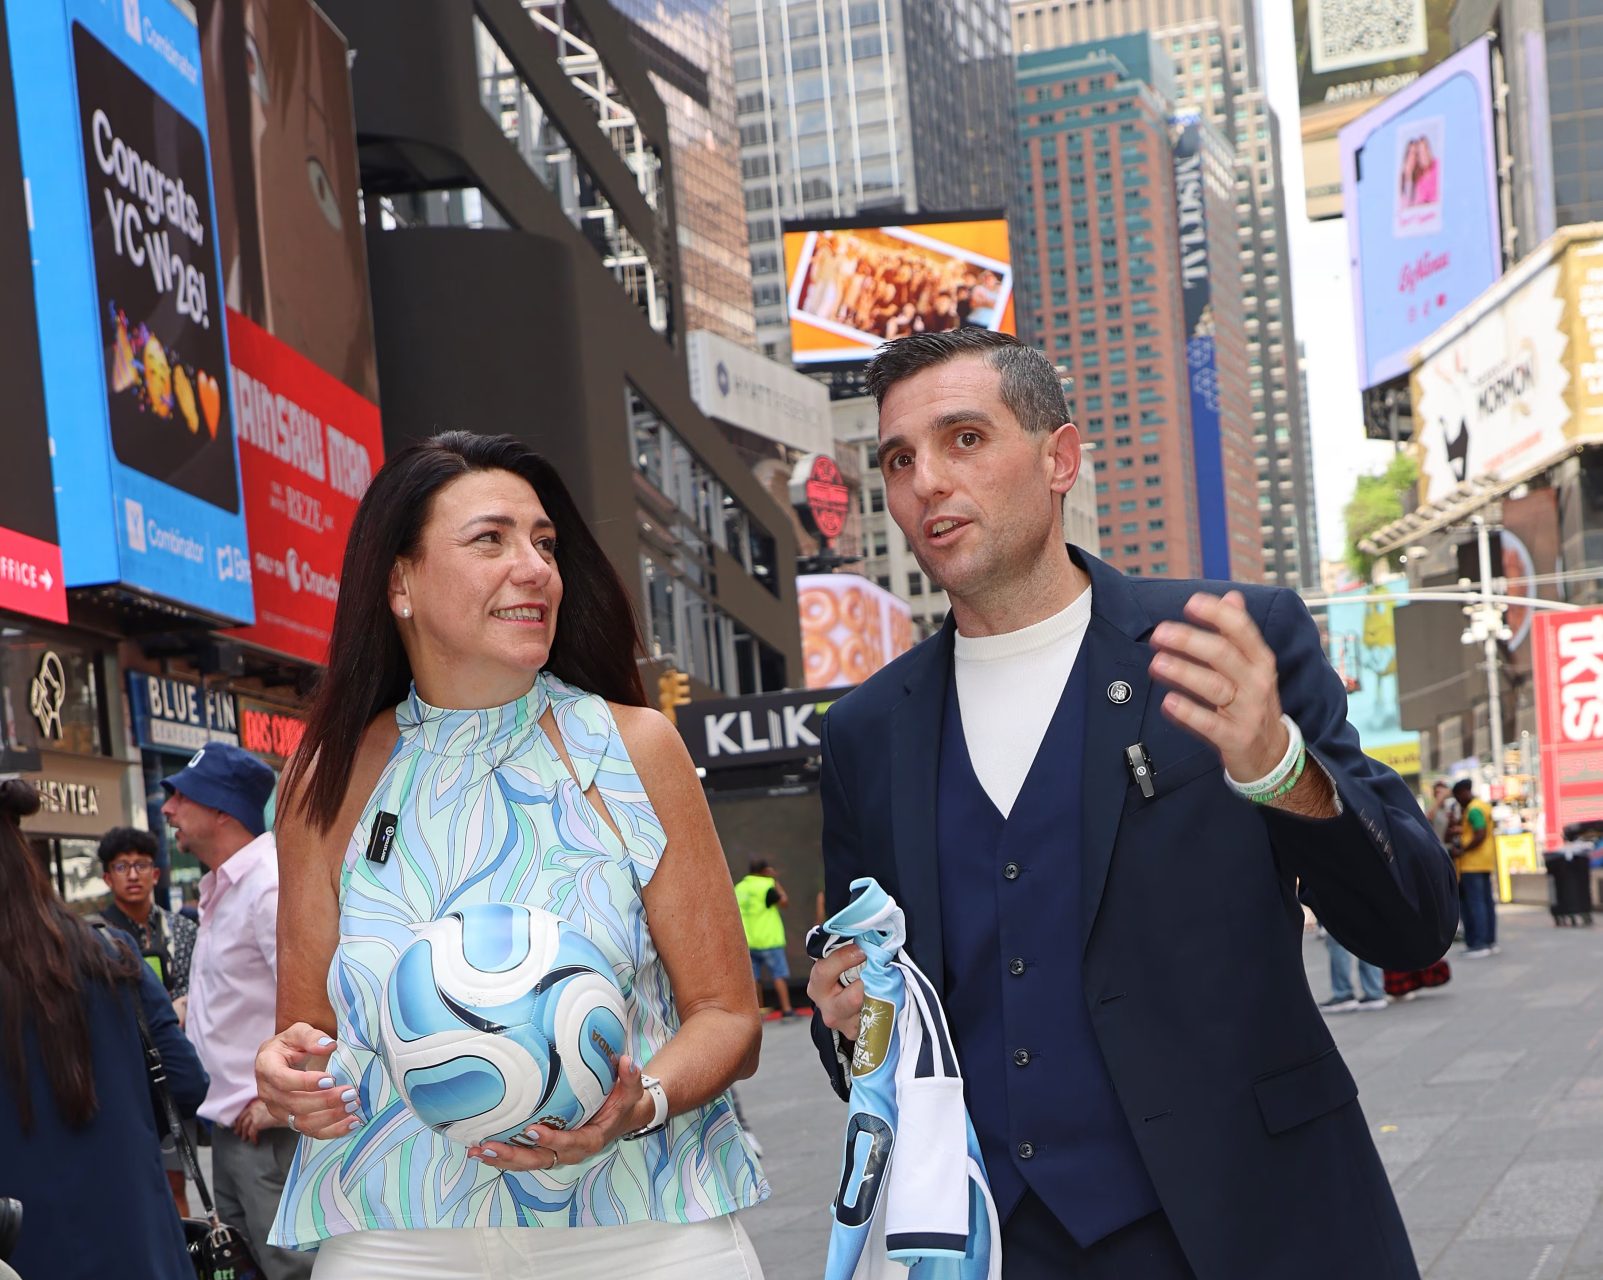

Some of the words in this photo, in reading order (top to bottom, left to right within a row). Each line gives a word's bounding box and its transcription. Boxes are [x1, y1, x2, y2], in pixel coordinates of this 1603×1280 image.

[104, 187, 145, 267] YC
[144, 230, 210, 330] W26!
[231, 364, 325, 483] AINSAW
[147, 518, 204, 565] Combinator
[0, 556, 38, 589] FFICE
[148, 676, 199, 724] BLUE
[206, 691, 236, 730] FIN
[704, 702, 820, 757] KLIK
[36, 780, 99, 815] HEYTEA
